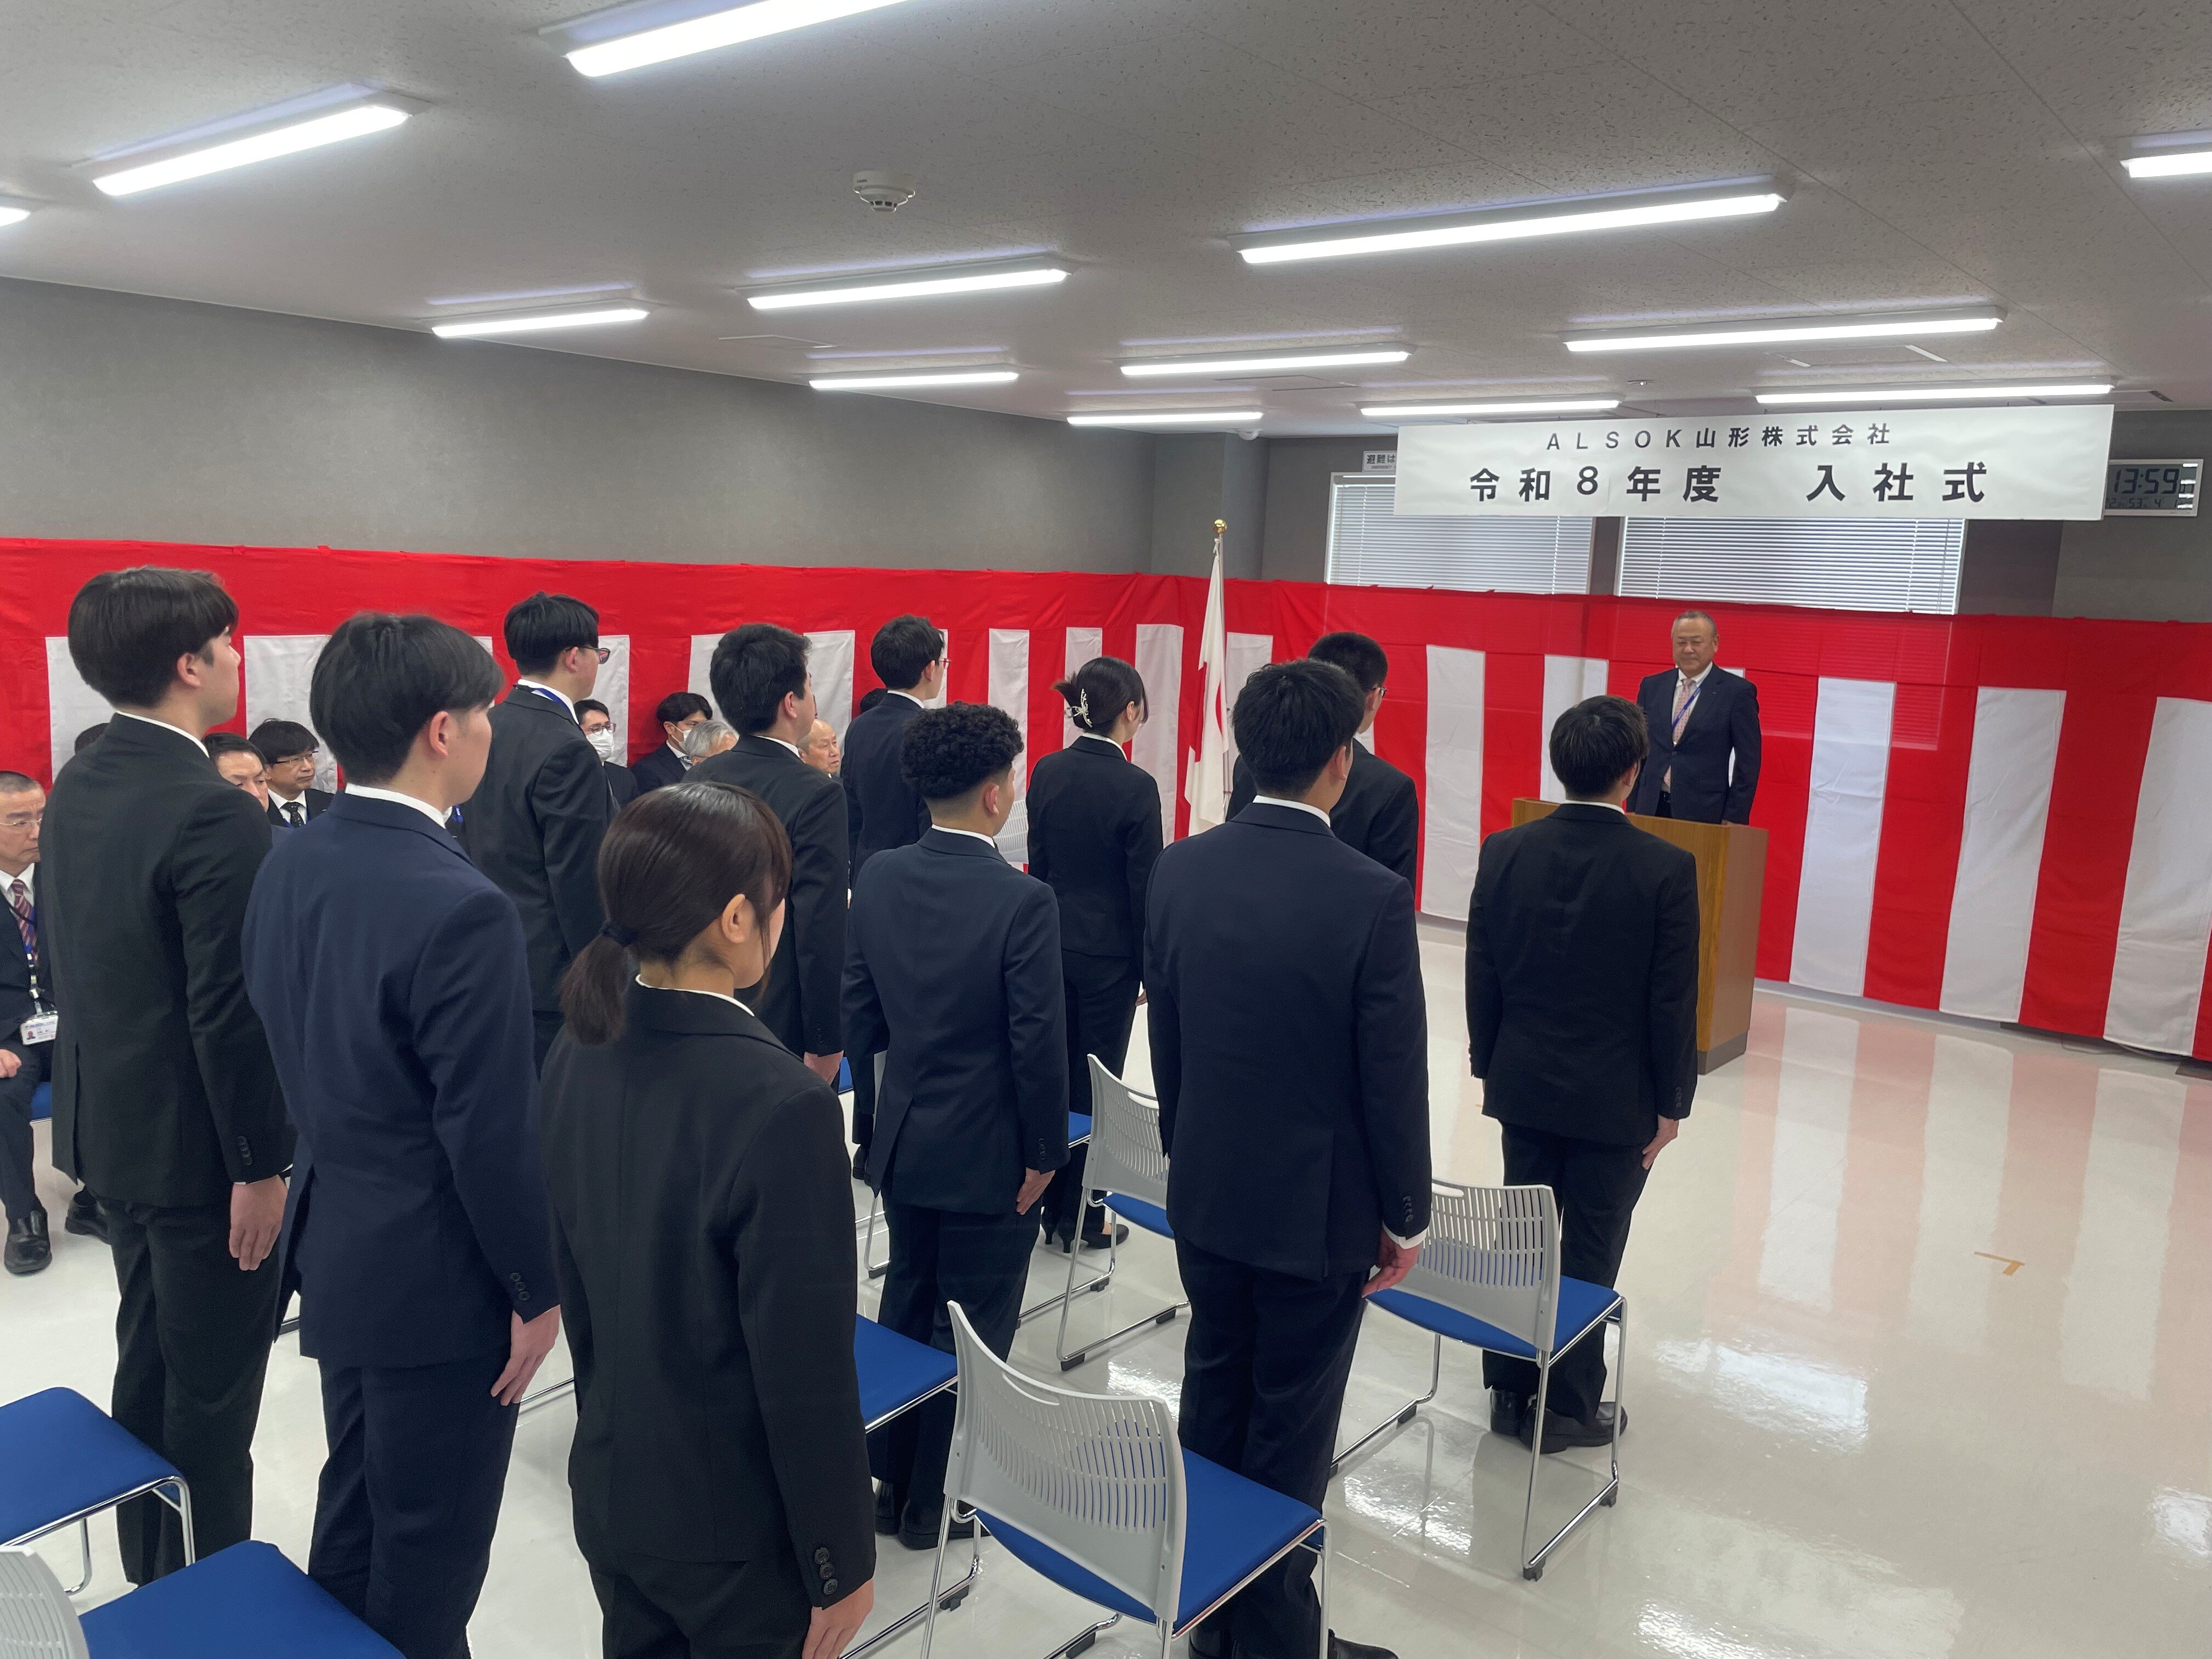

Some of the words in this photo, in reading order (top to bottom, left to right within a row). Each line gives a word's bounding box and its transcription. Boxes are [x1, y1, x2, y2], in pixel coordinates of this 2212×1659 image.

[1546, 423, 1891, 450] ALSOK山形株式会社
[1470, 465, 1722, 503] 令和8年度
[1806, 461, 1987, 503] 入社式
[2114, 469, 2180, 494] 13:59
